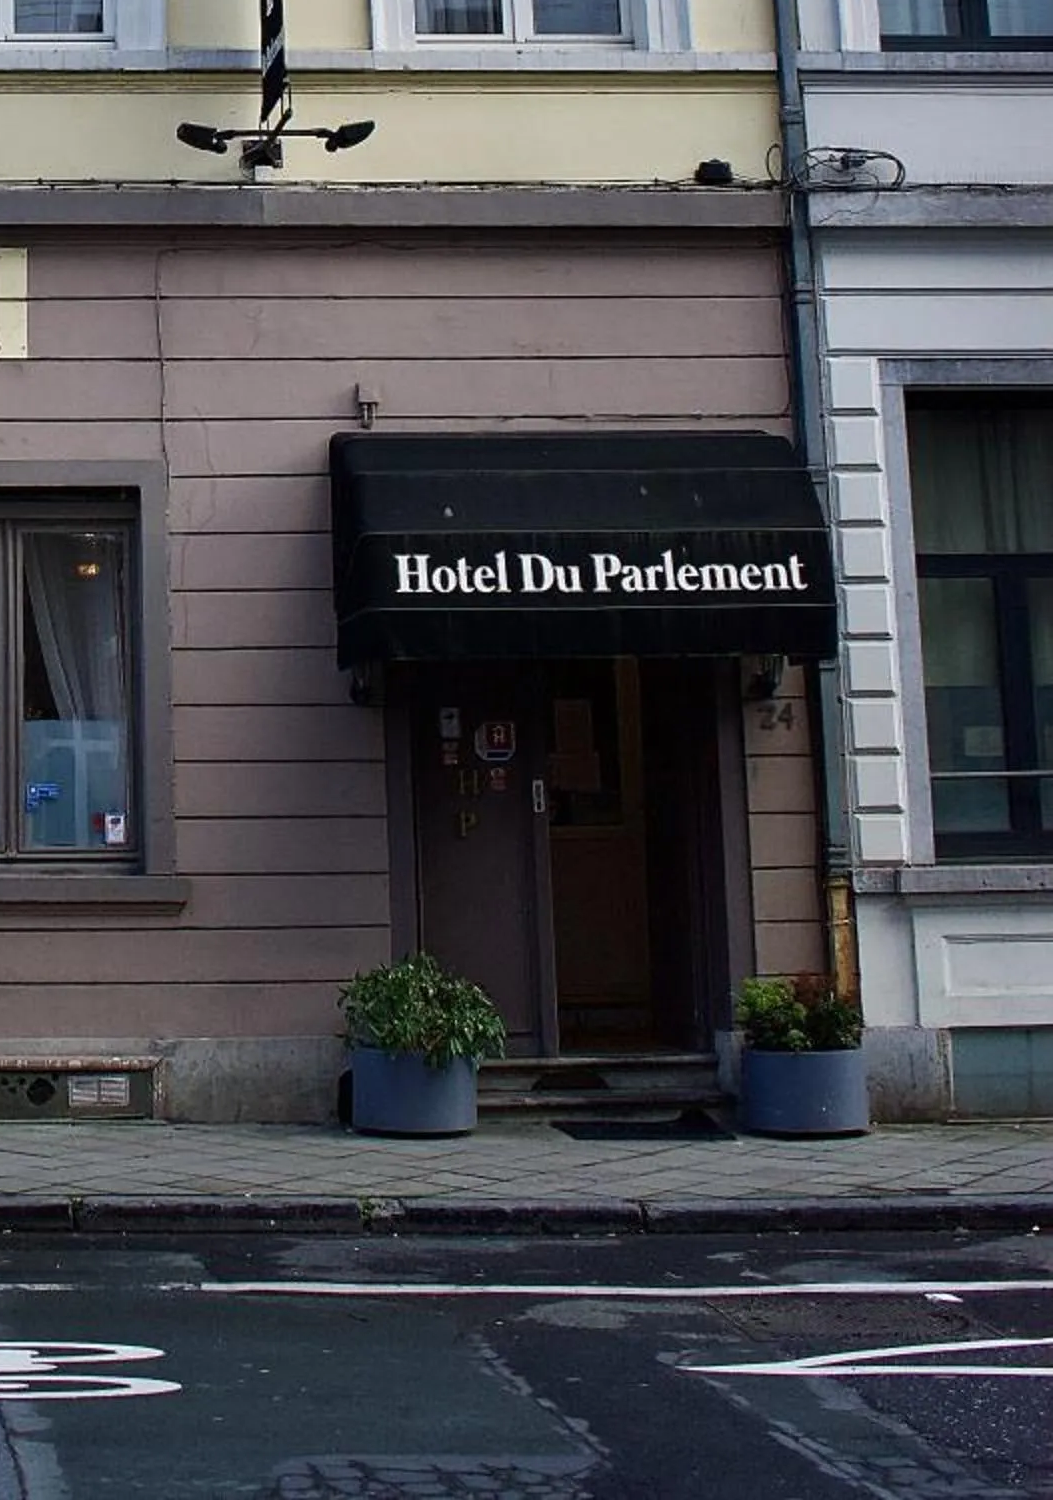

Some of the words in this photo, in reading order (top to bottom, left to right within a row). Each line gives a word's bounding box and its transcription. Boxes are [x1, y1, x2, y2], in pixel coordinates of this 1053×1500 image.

[394, 550, 512, 593] Hotel
[517, 552, 584, 593] Du
[591, 549, 808, 592] Parlement
[756, 702, 793, 731] 24
